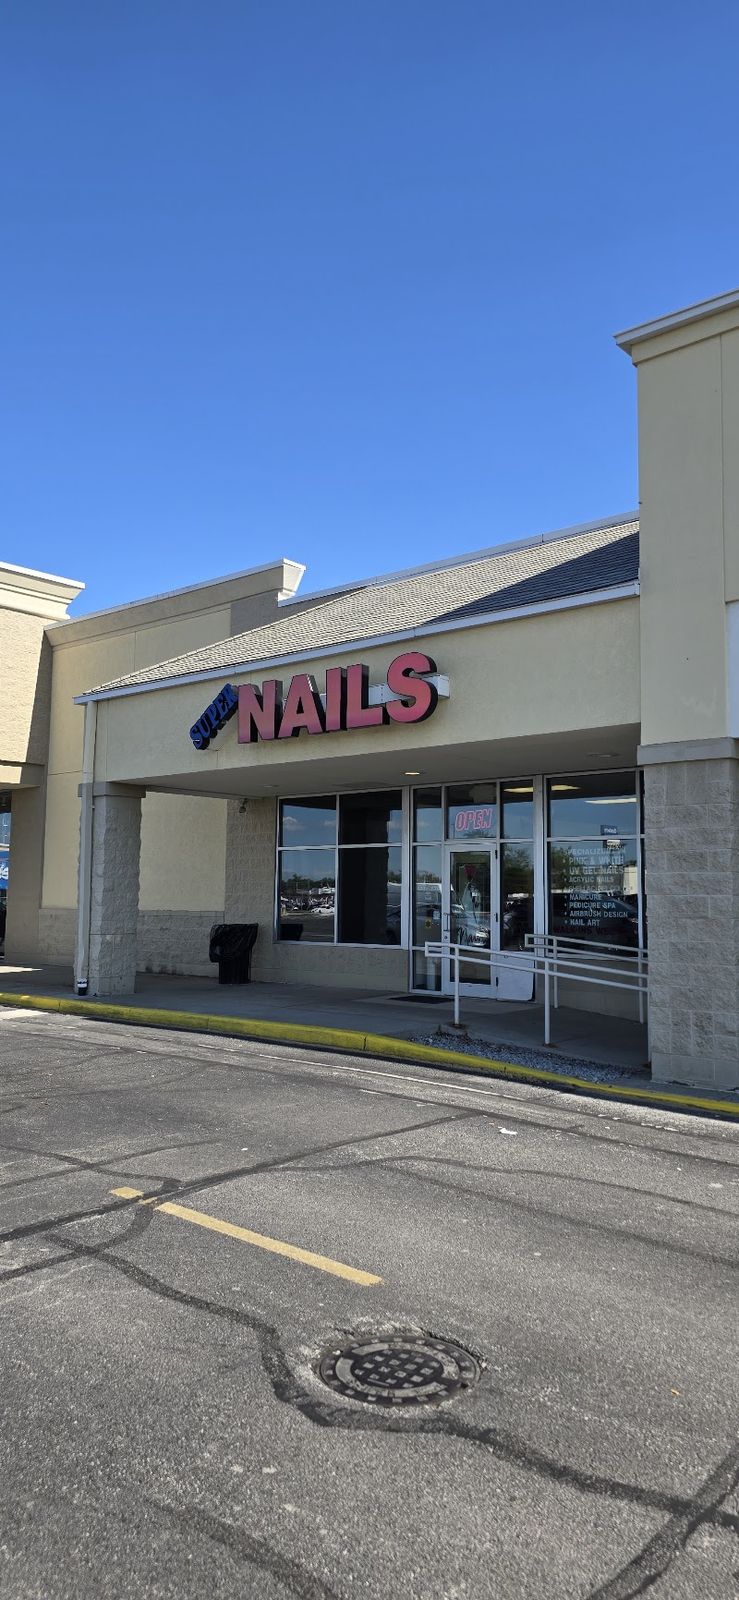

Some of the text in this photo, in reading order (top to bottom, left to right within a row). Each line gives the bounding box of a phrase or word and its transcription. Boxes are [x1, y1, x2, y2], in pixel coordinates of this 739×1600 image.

[237, 652, 437, 744] NAILS
[189, 683, 238, 749] SUPER
[455, 808, 493, 831] OPEN
[568, 866, 624, 875] UV GEL NAILS
[569, 893, 602, 901] MANICURE
[569, 901, 601, 909] PEDICURE
[569, 910, 602, 918] AIRBRUSH
[570, 918, 601, 927] NAIL ART
